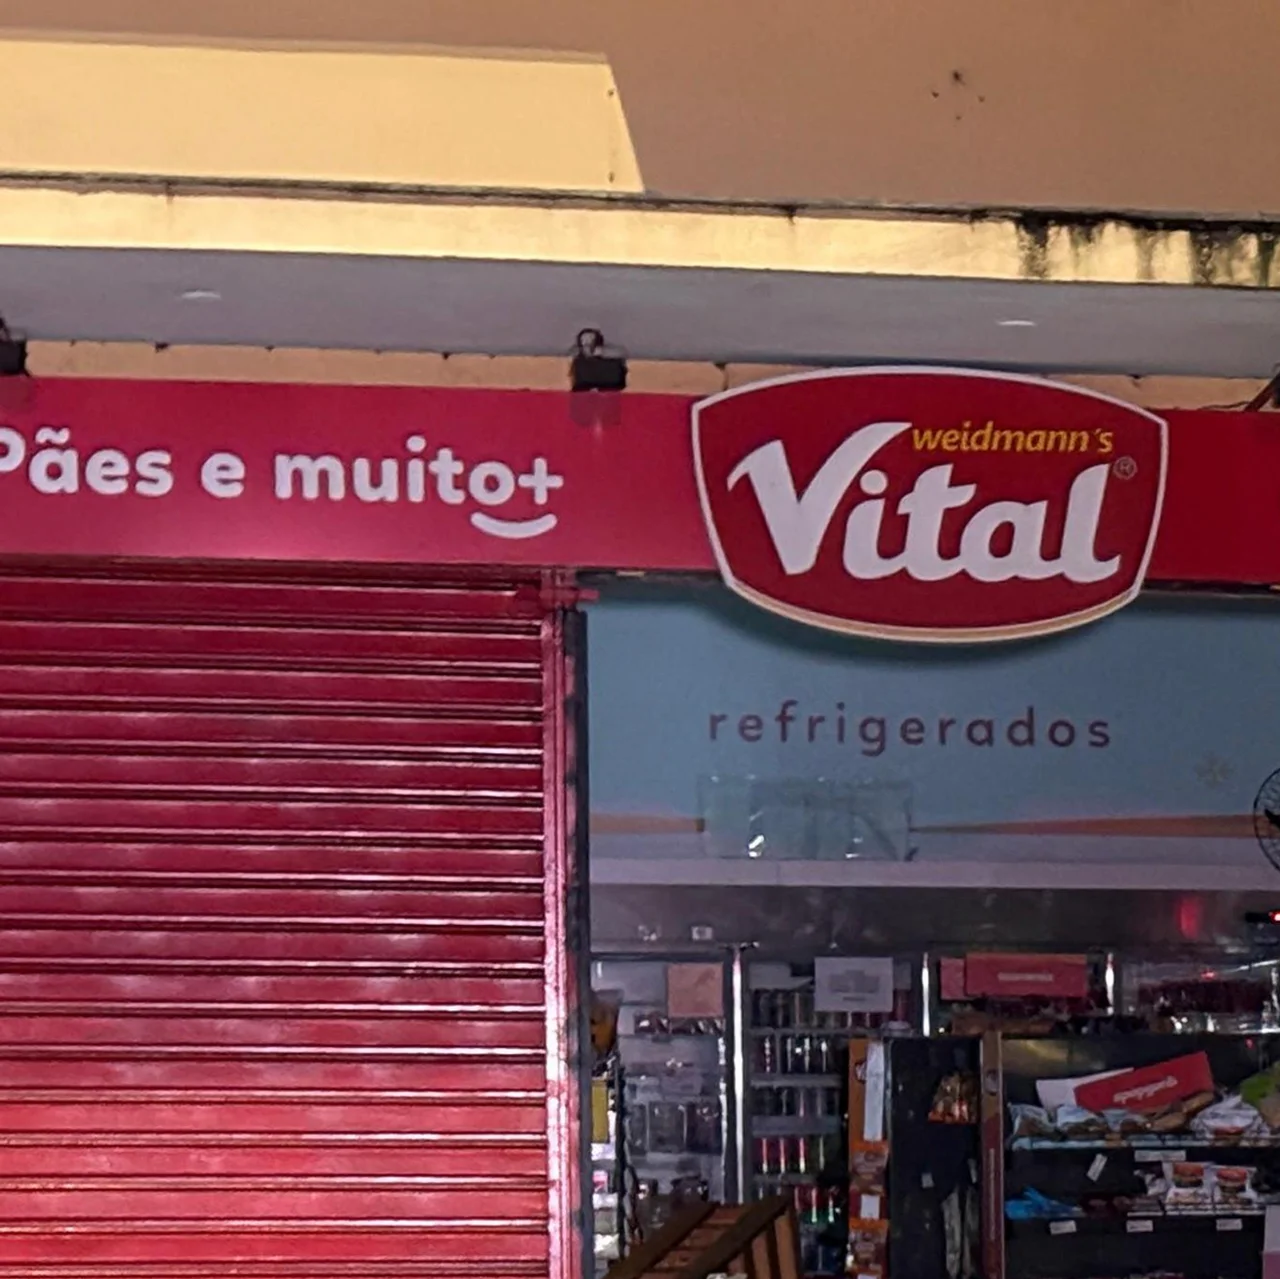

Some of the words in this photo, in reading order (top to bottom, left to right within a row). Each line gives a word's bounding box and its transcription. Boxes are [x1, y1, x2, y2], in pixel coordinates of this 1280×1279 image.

[201, 452, 246, 499] e
[726, 421, 1121, 584] Vital
[707, 700, 1112, 757] refrigerados
